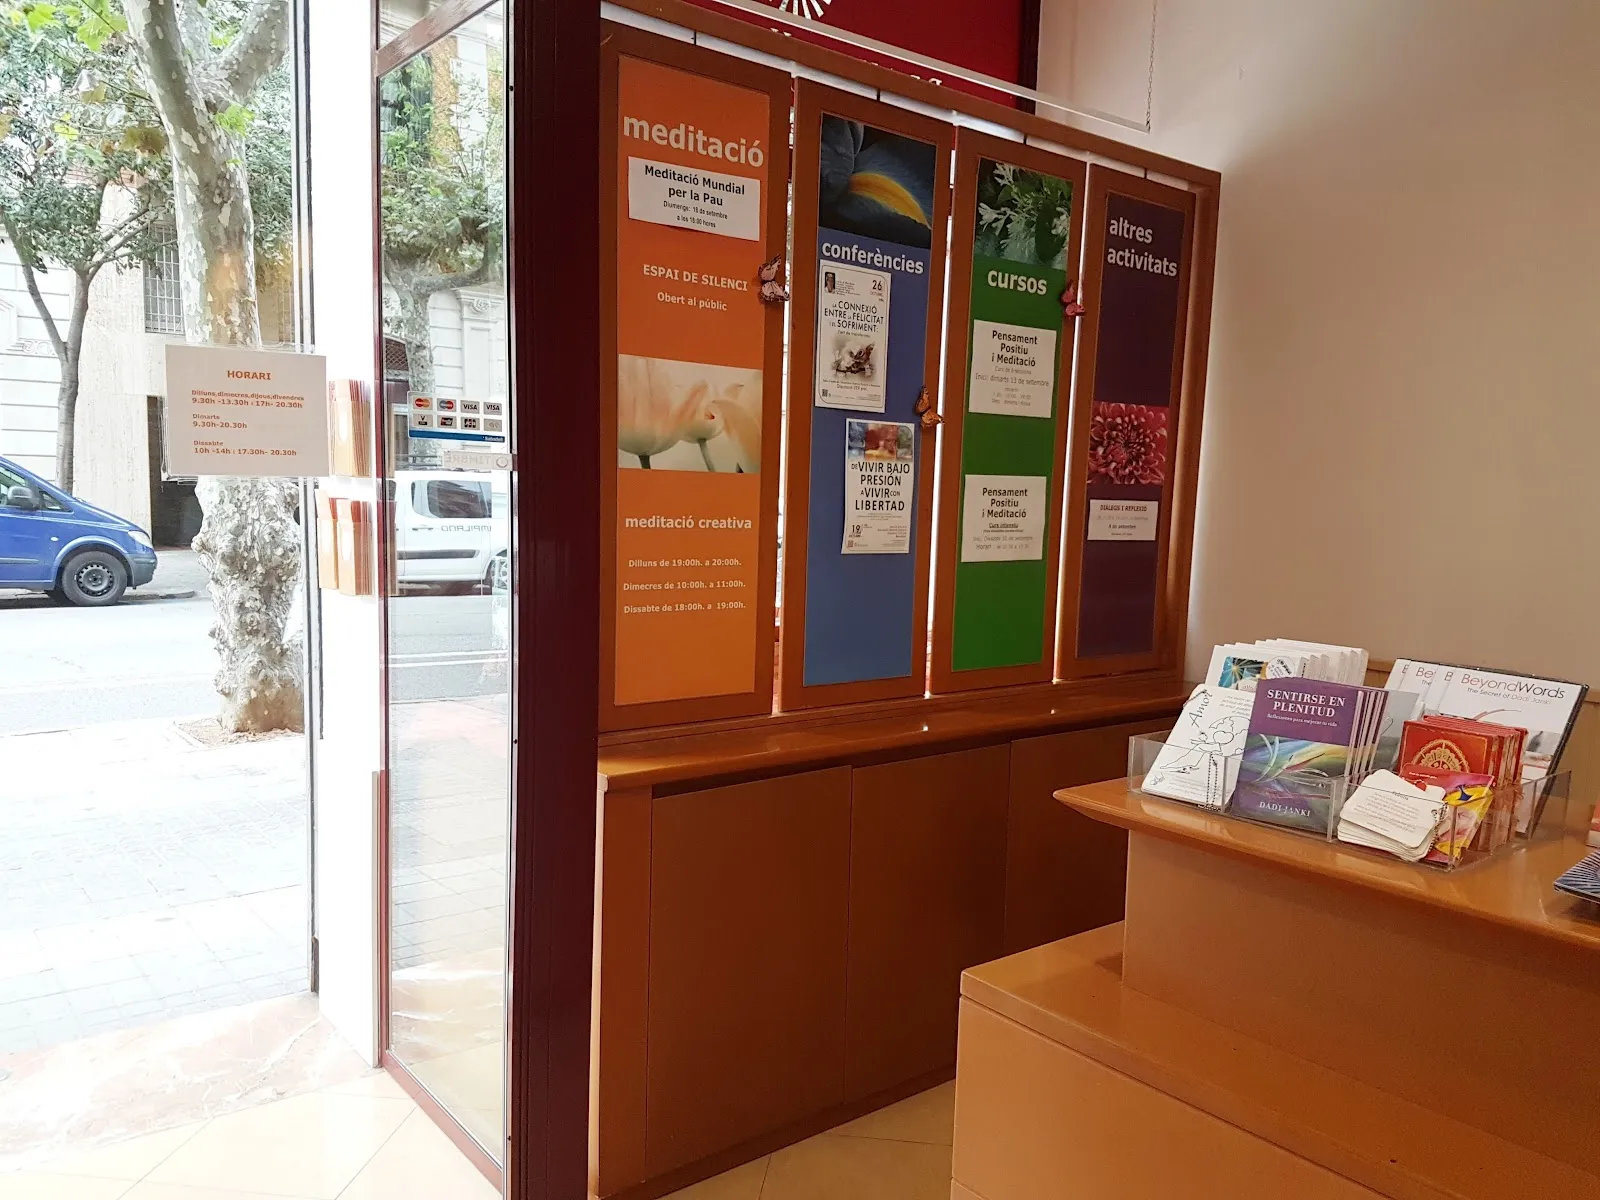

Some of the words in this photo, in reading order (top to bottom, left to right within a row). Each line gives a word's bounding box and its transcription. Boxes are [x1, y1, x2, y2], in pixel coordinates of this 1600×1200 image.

[623, 115, 764, 168] meditació
[644, 164, 699, 186] Meditació
[702, 177, 745, 195] Mundial
[668, 186, 687, 199] per
[690, 189, 700, 201] la
[703, 192, 723, 206] Pau
[706, 210, 728, 219] setembre
[702, 219, 716, 228] hores
[1109, 216, 1153, 244] altres
[822, 242, 924, 274] conferències
[1107, 247, 1178, 277] activitats
[643, 264, 679, 280] ESPAI
[683, 271, 698, 283] DE
[702, 274, 748, 292] SILENCI
[987, 269, 1047, 295] cursos
[872, 280, 882, 291] 26
[657, 292, 685, 305] Obert
[687, 296, 697, 306] al
[699, 297, 728, 311] públic
[838, 300, 877, 314] CONNEXIÓ
[824, 308, 847, 319] ENTRE
[853, 313, 884, 324] FELICITAT
[837, 320, 878, 332] SOFRIMENT:
[992, 330, 1038, 344] Pensament
[1000, 343, 1028, 355] Positiu
[992, 353, 994, 362] i
[996, 354, 1036, 367] Meditació
[227, 370, 271, 380] HORARI
[192, 421, 248, 429] 9.30h-20.30h
[858, 462, 884, 473] VIVIR
[887, 463, 910, 474] BAJO
[860, 473, 902, 486] PRESIÓN
[864, 488, 890, 498] VIVIR
[982, 488, 1028, 497] Pensament
[855, 500, 905, 511] LIBERTAD
[990, 498, 1019, 507] Positiu
[982, 509, 984, 518] i
[987, 508, 1026, 518] Meditació
[625, 516, 694, 528] meditació
[699, 517, 752, 529] creativa
[623, 582, 662, 590] Dimecres
[624, 605, 660, 614] Dissabte
[674, 603, 704, 611] 18:00h.
[1461, 673, 1566, 699] BeyondWords
[1267, 689, 1326, 704] SENTIRSE
[1329, 696, 1346, 707] EN
[1480, 689, 1500, 698] Secret
[1189, 690, 1213, 728] Amor
[1273, 701, 1335, 718] PLENITUD
[1259, 801, 1282, 813] DADI
[1283, 805, 1311, 817] JANKI
